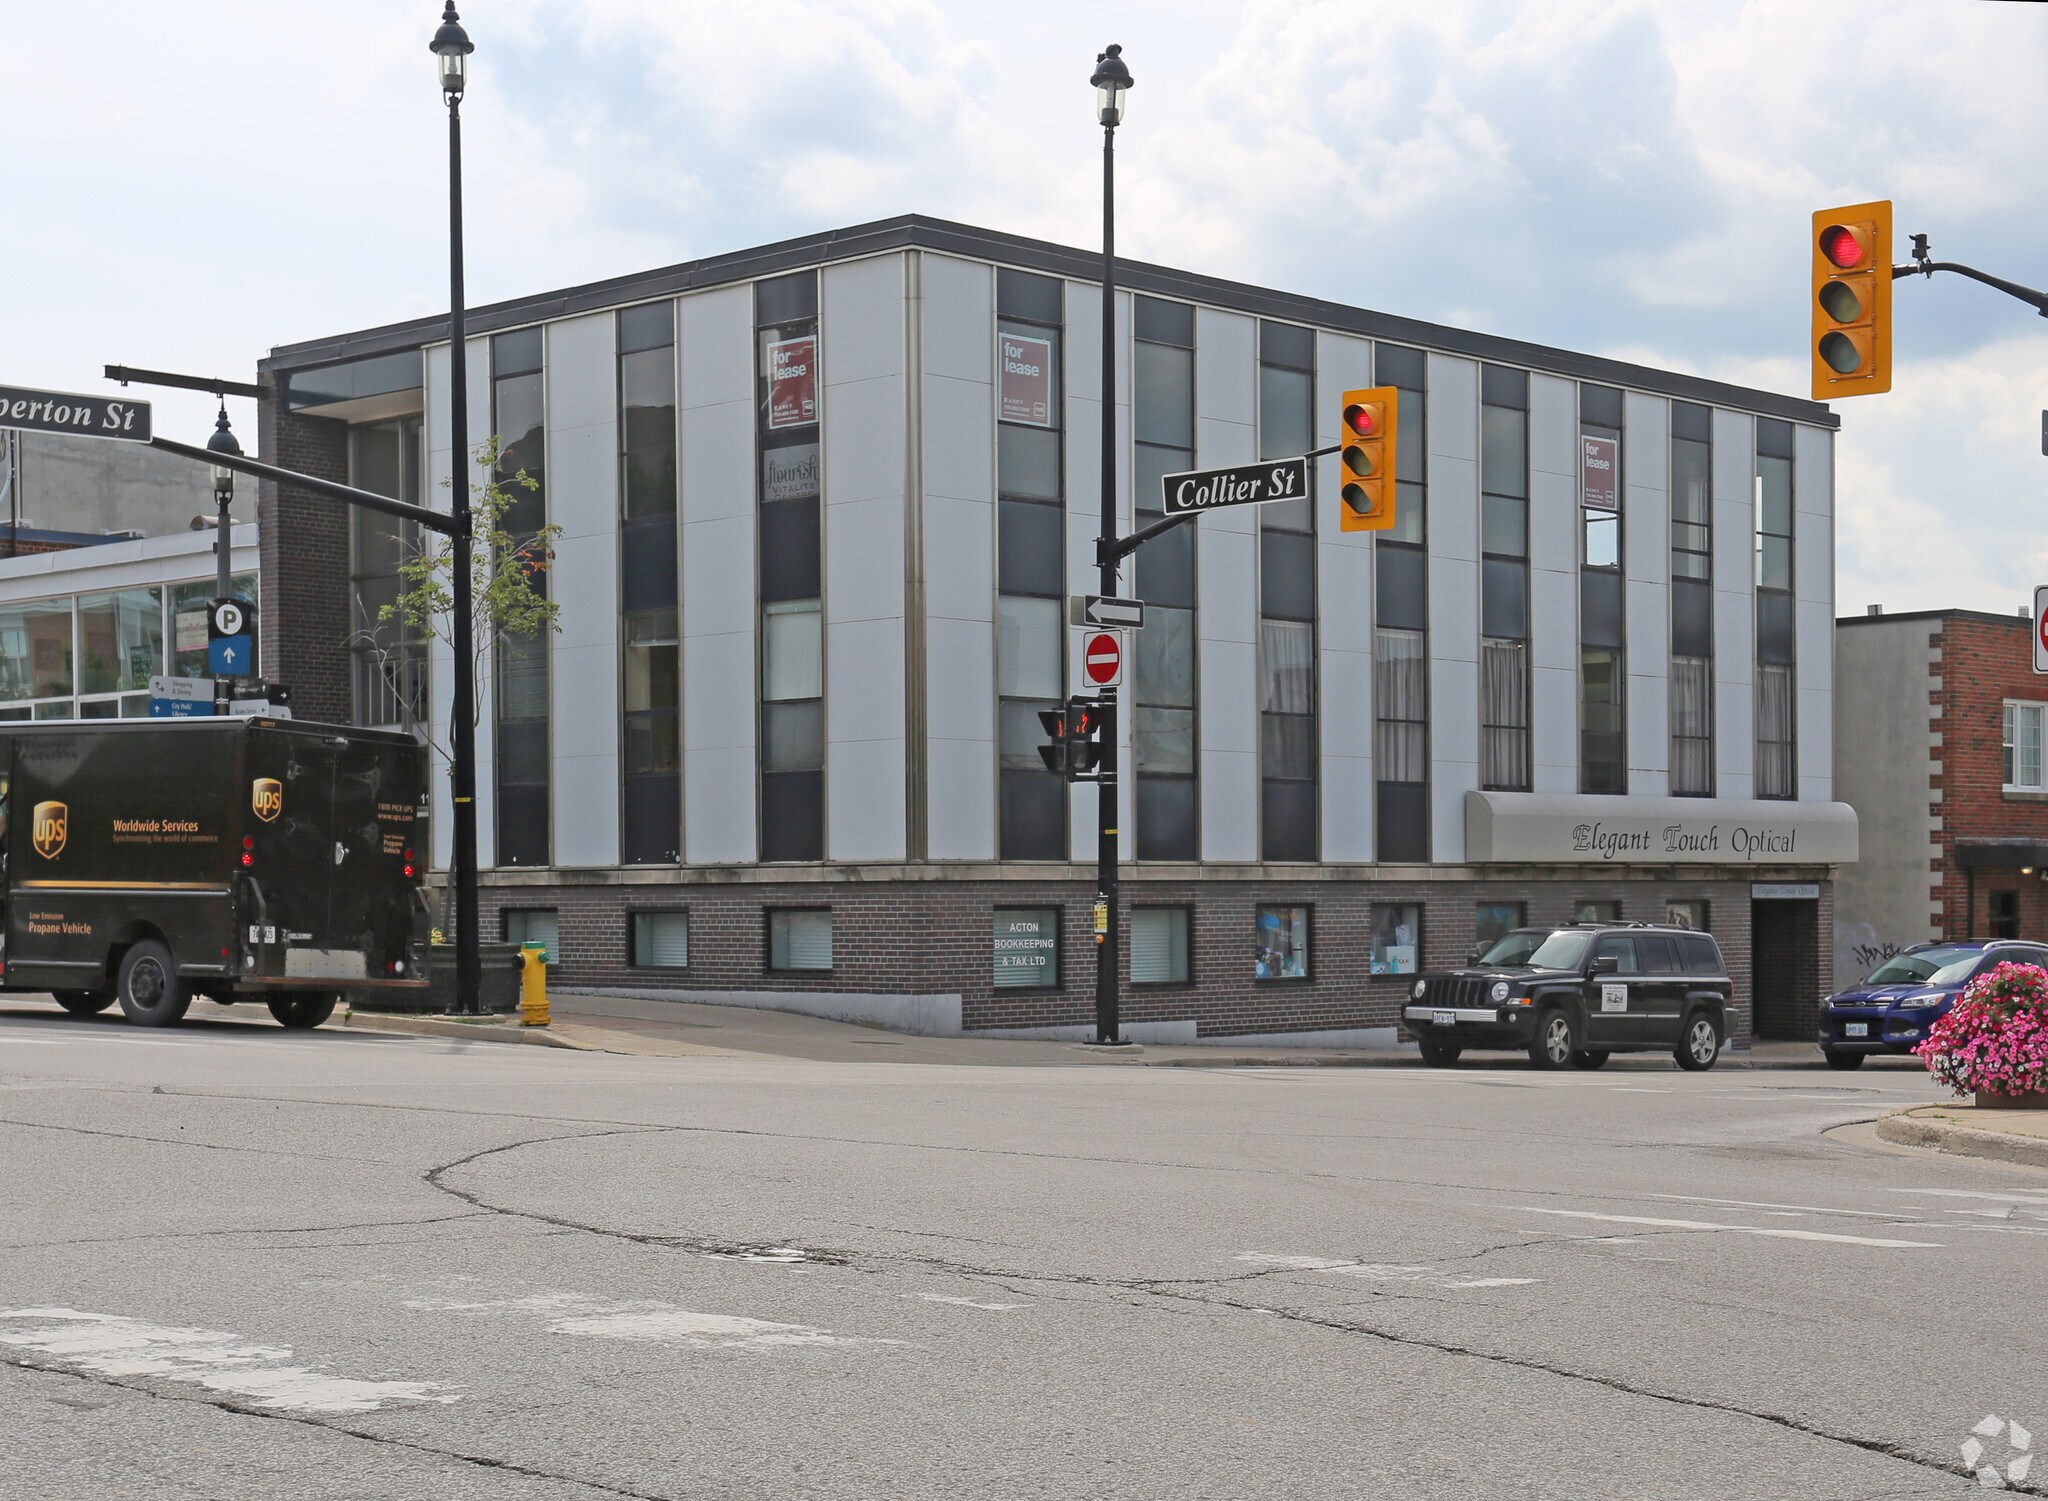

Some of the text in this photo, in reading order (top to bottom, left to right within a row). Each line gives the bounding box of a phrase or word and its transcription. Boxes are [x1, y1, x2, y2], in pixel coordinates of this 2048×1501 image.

[773, 350, 792, 365] for
[1004, 342, 1023, 358] for
[773, 364, 807, 381] lease
[1005, 358, 1039, 377] lease
[102, 402, 136, 431] St
[1585, 442, 1599, 456] for
[1586, 455, 1610, 470] lease
[766, 454, 818, 489] flourish
[773, 482, 815, 494] VITALITY
[1177, 467, 1295, 508] Collier St
[223, 610, 237, 630] P
[255, 791, 280, 815] ups
[113, 819, 198, 832] Worldwide Services
[35, 819, 65, 850] ups
[1572, 822, 1796, 861] Elegant Touch Optical
[29, 911, 64, 920] Low Emission
[28, 921, 92, 935] Propane Vehicle
[1009, 922, 1039, 933] ACTON
[994, 939, 1054, 949] BOOKKEEPING
[1002, 956, 1046, 966] & TAX LTD
